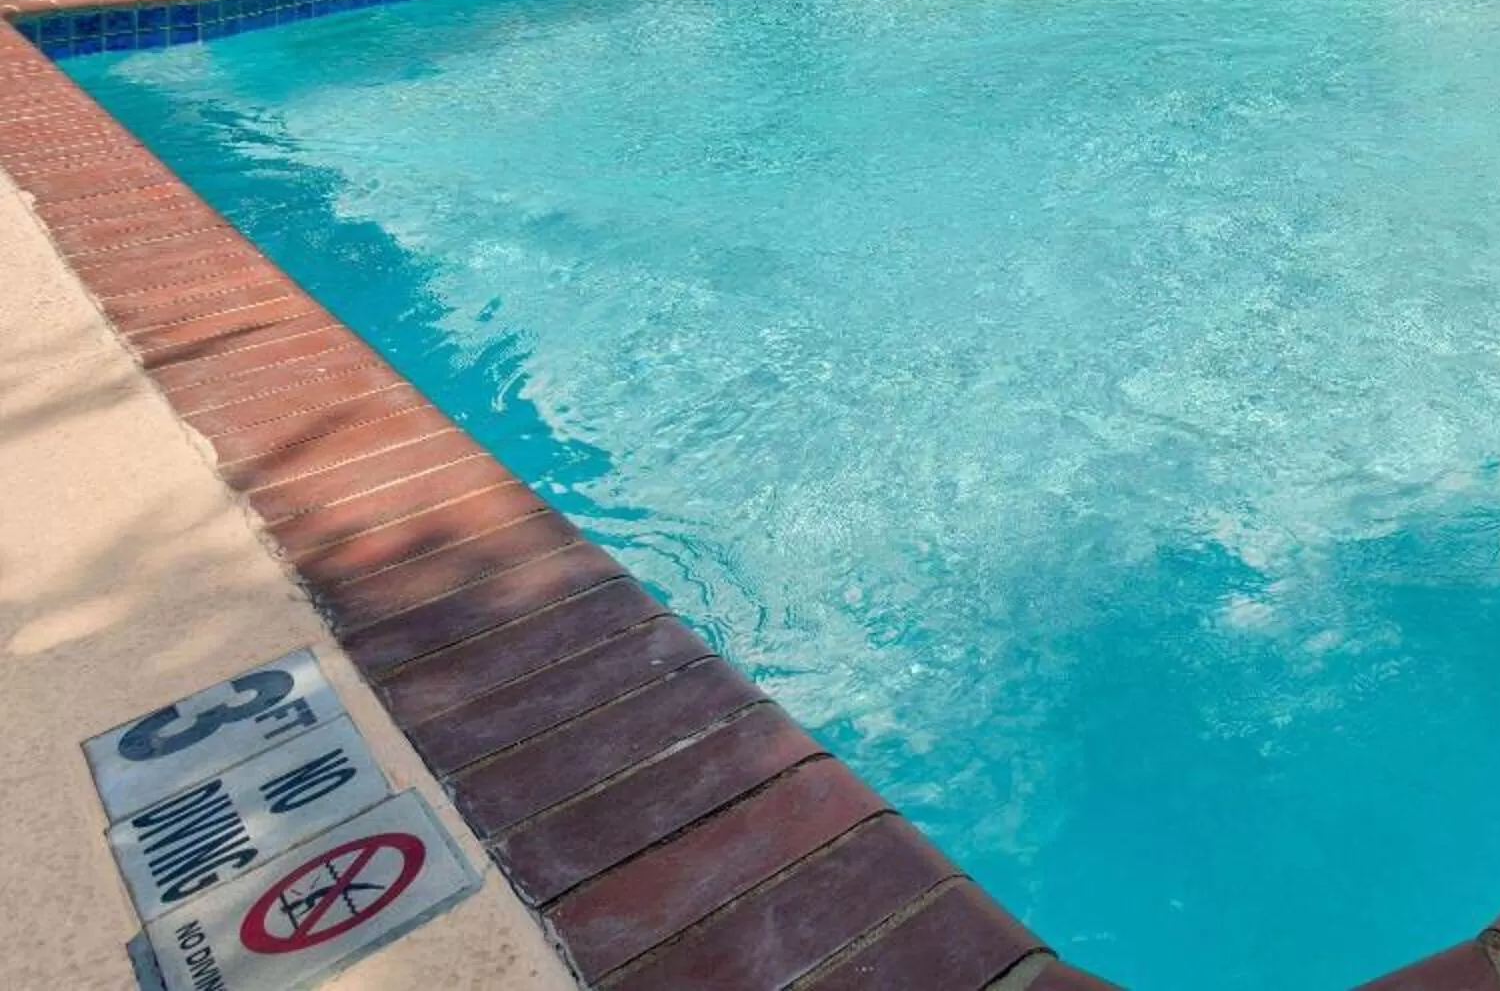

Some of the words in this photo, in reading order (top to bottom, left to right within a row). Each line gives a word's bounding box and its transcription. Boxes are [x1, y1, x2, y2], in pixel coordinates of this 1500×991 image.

[117, 668, 296, 762] 3
[254, 696, 319, 741] FT
[258, 748, 358, 814] NO
[131, 778, 259, 904] DIVING
[175, 919, 206, 950] NO
[186, 945, 228, 991] DIVIN
